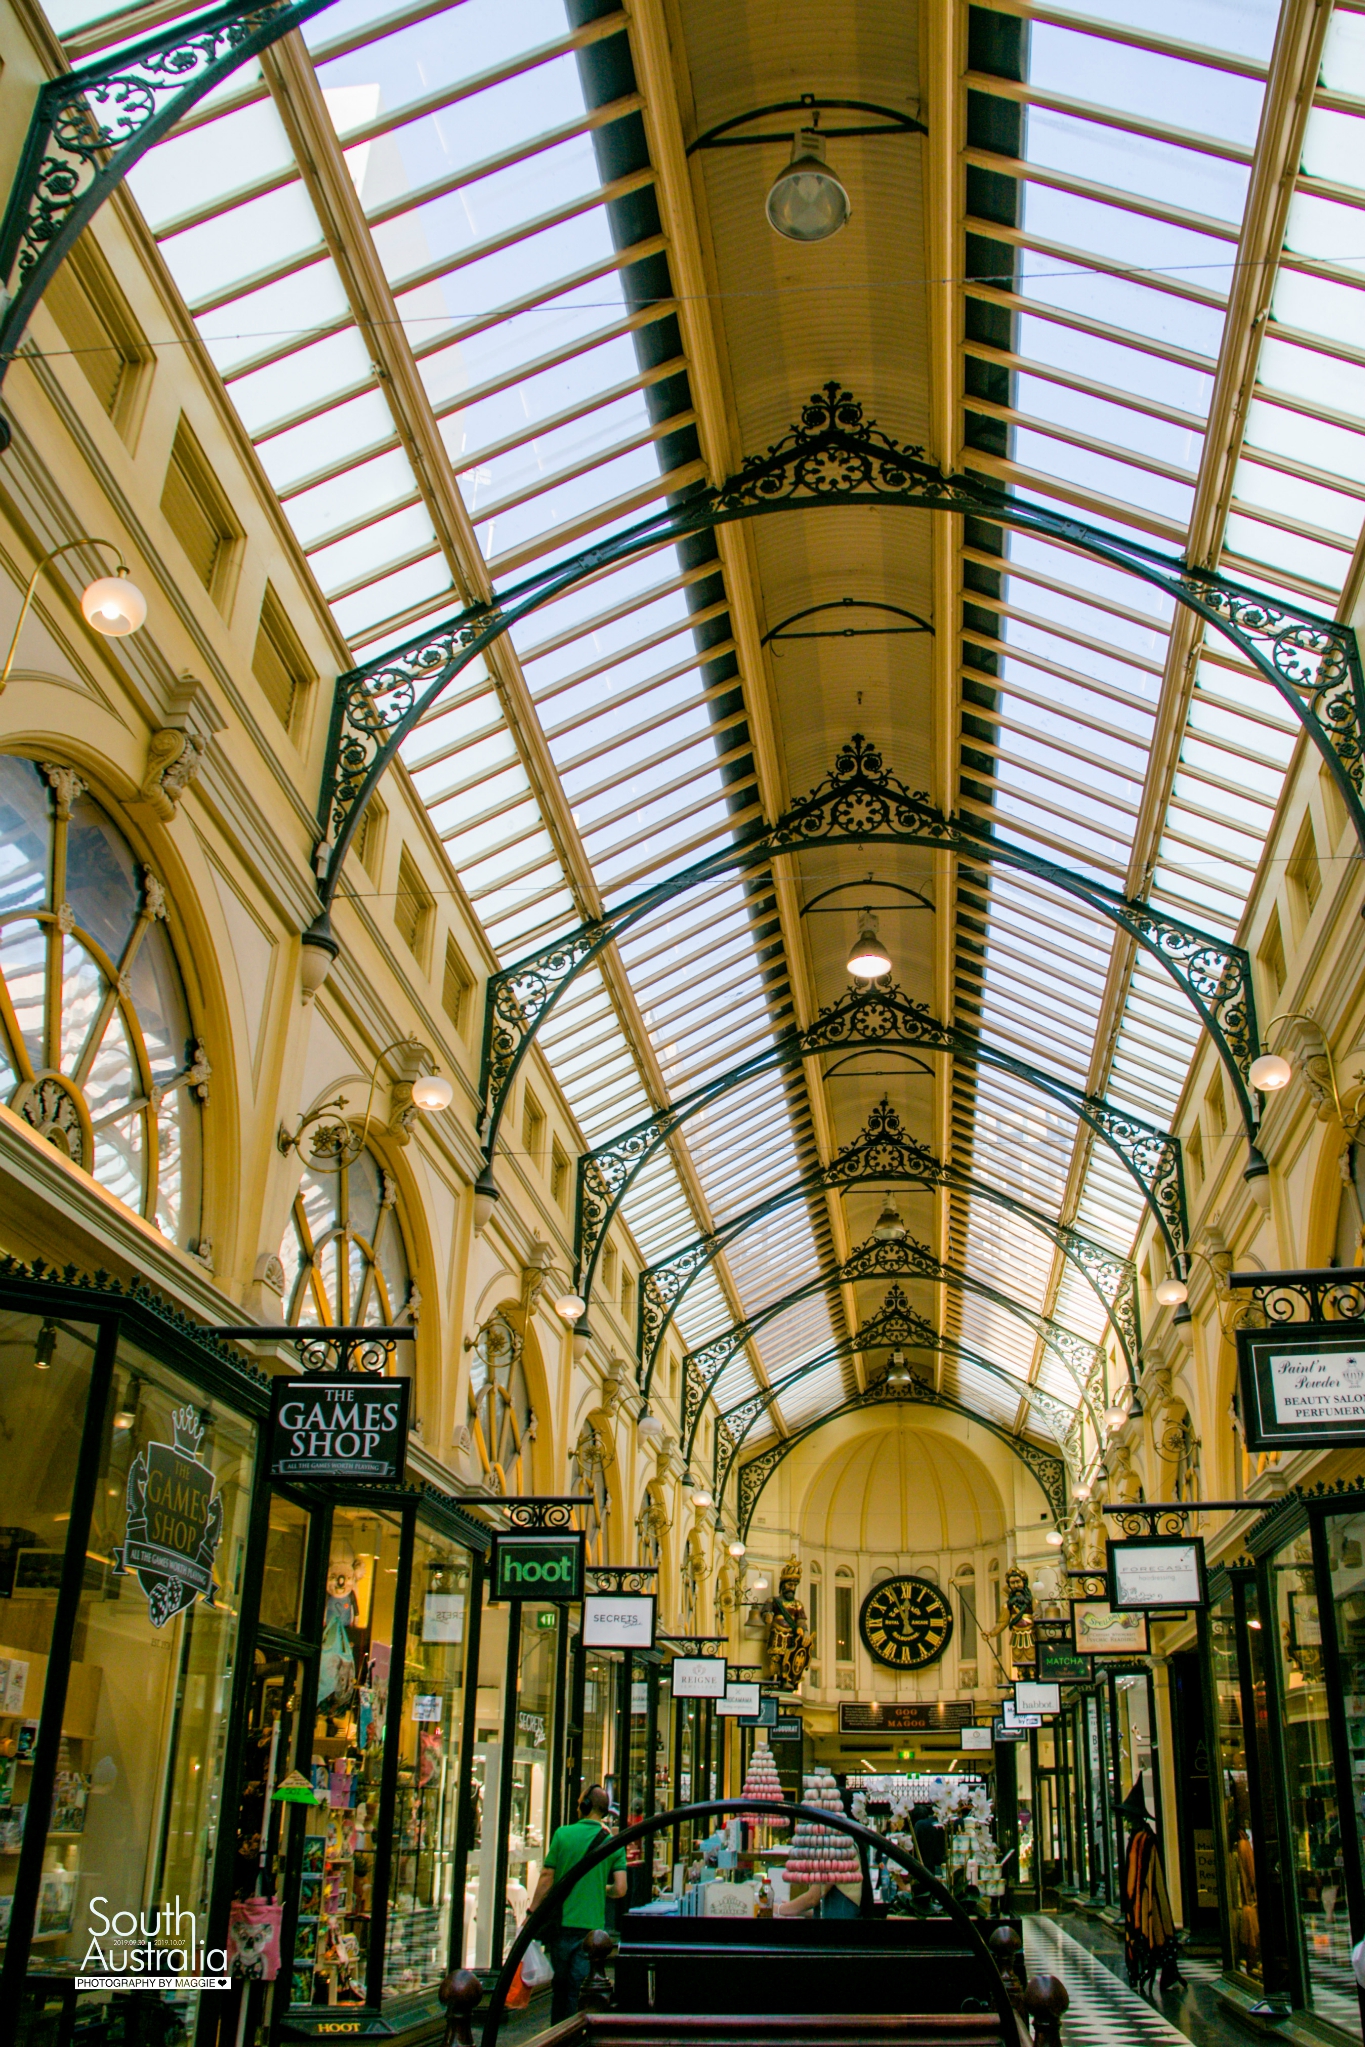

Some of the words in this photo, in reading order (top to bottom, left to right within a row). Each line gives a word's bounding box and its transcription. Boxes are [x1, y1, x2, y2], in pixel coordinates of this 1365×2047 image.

[1294, 1375, 1340, 1389] Powder
[324, 1389, 355, 1402] THE
[1284, 1395, 1331, 1406] BEAUTY
[278, 1402, 398, 1431] GAMES
[290, 1431, 380, 1458] SHOP
[175, 1461, 190, 1480] THE
[354, 1463, 380, 1471] PLAYING
[148, 1470, 208, 1524] GAMES
[152, 1512, 197, 1552] SHOP
[130, 1549, 141, 1560] ALL
[140, 1551, 152, 1563] THE
[151, 1553, 169, 1569] GAMES
[168, 1559, 188, 1575] WORTH
[187, 1567, 207, 1585] PLAYING
[503, 1555, 571, 1582] hoot
[593, 1614, 638, 1623] SECRETS
[1046, 1656, 1084, 1665] MATCHA
[681, 1676, 717, 1684] REIGNE
[519, 1711, 544, 1733] SECRETS
[317, 2023, 361, 2033] HOOT
